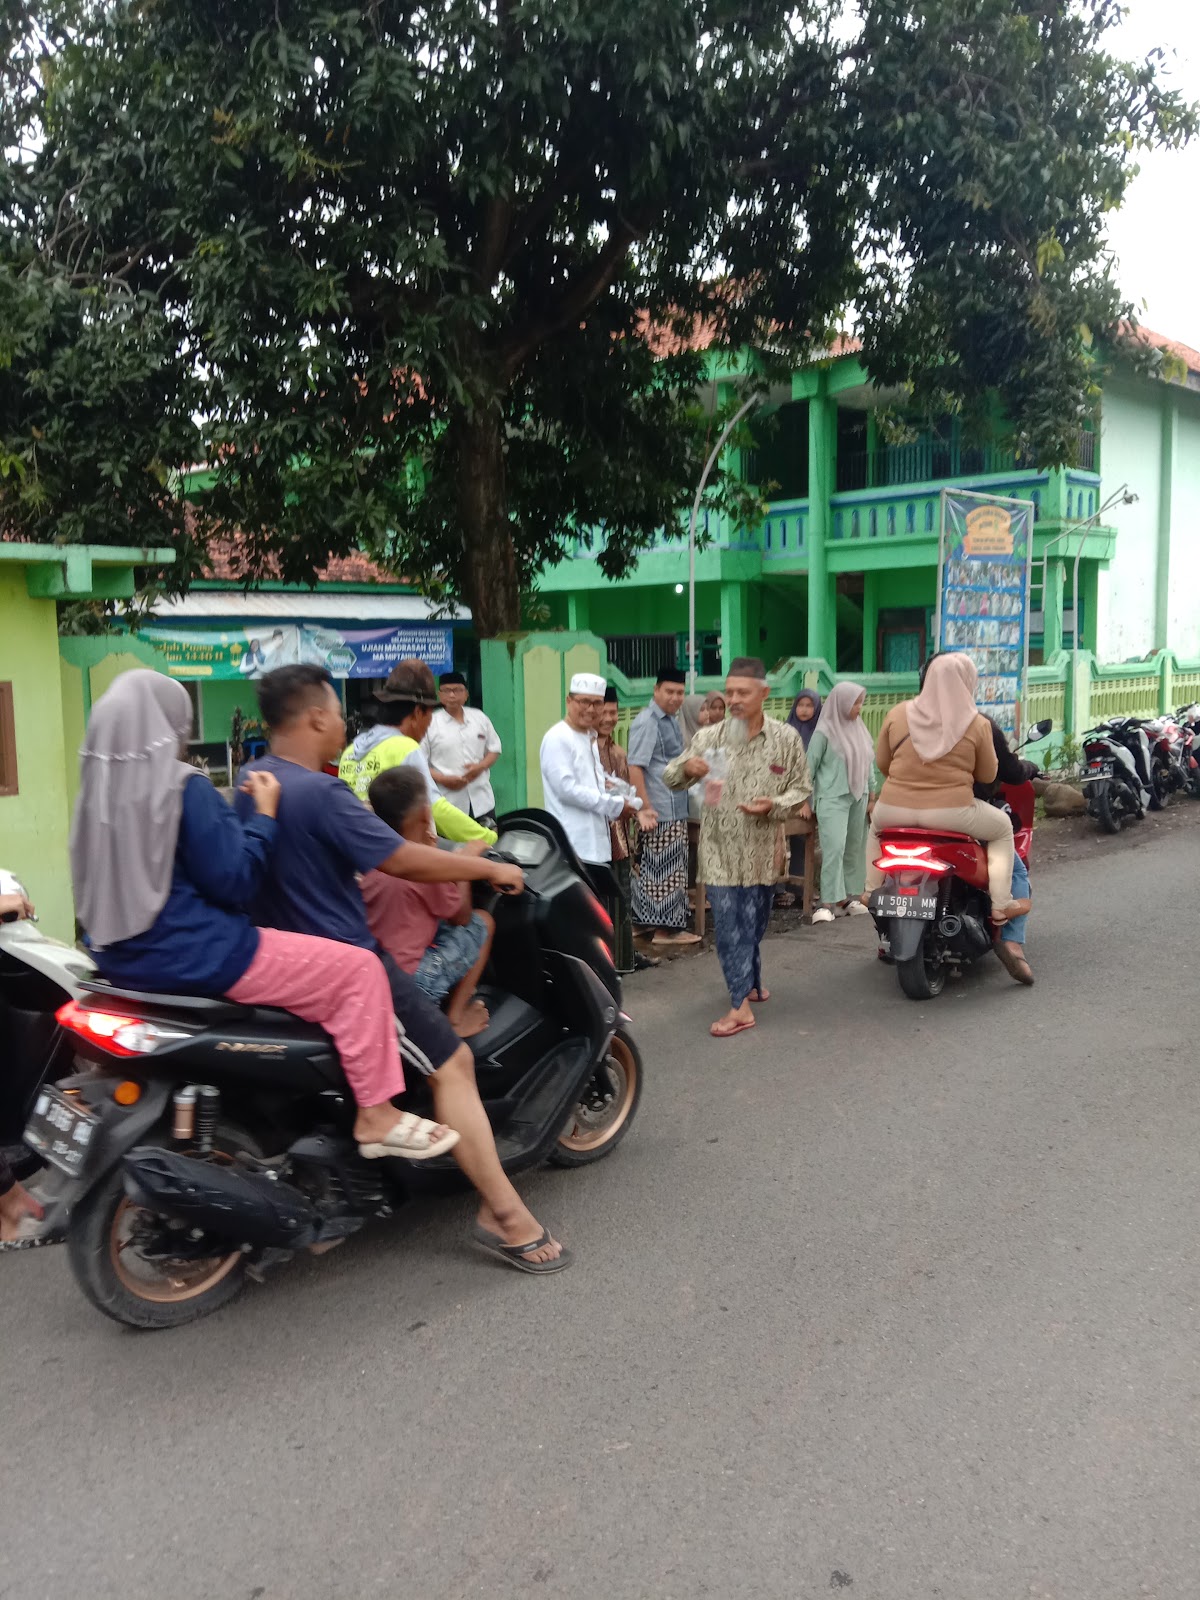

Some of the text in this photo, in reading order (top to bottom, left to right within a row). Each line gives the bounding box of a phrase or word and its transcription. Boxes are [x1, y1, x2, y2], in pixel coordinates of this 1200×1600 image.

[361, 642, 446, 653] UJIAN MADRASAH (UM)
[372, 653, 384, 661] MA
[877, 895, 936, 908] N 5061 MM
